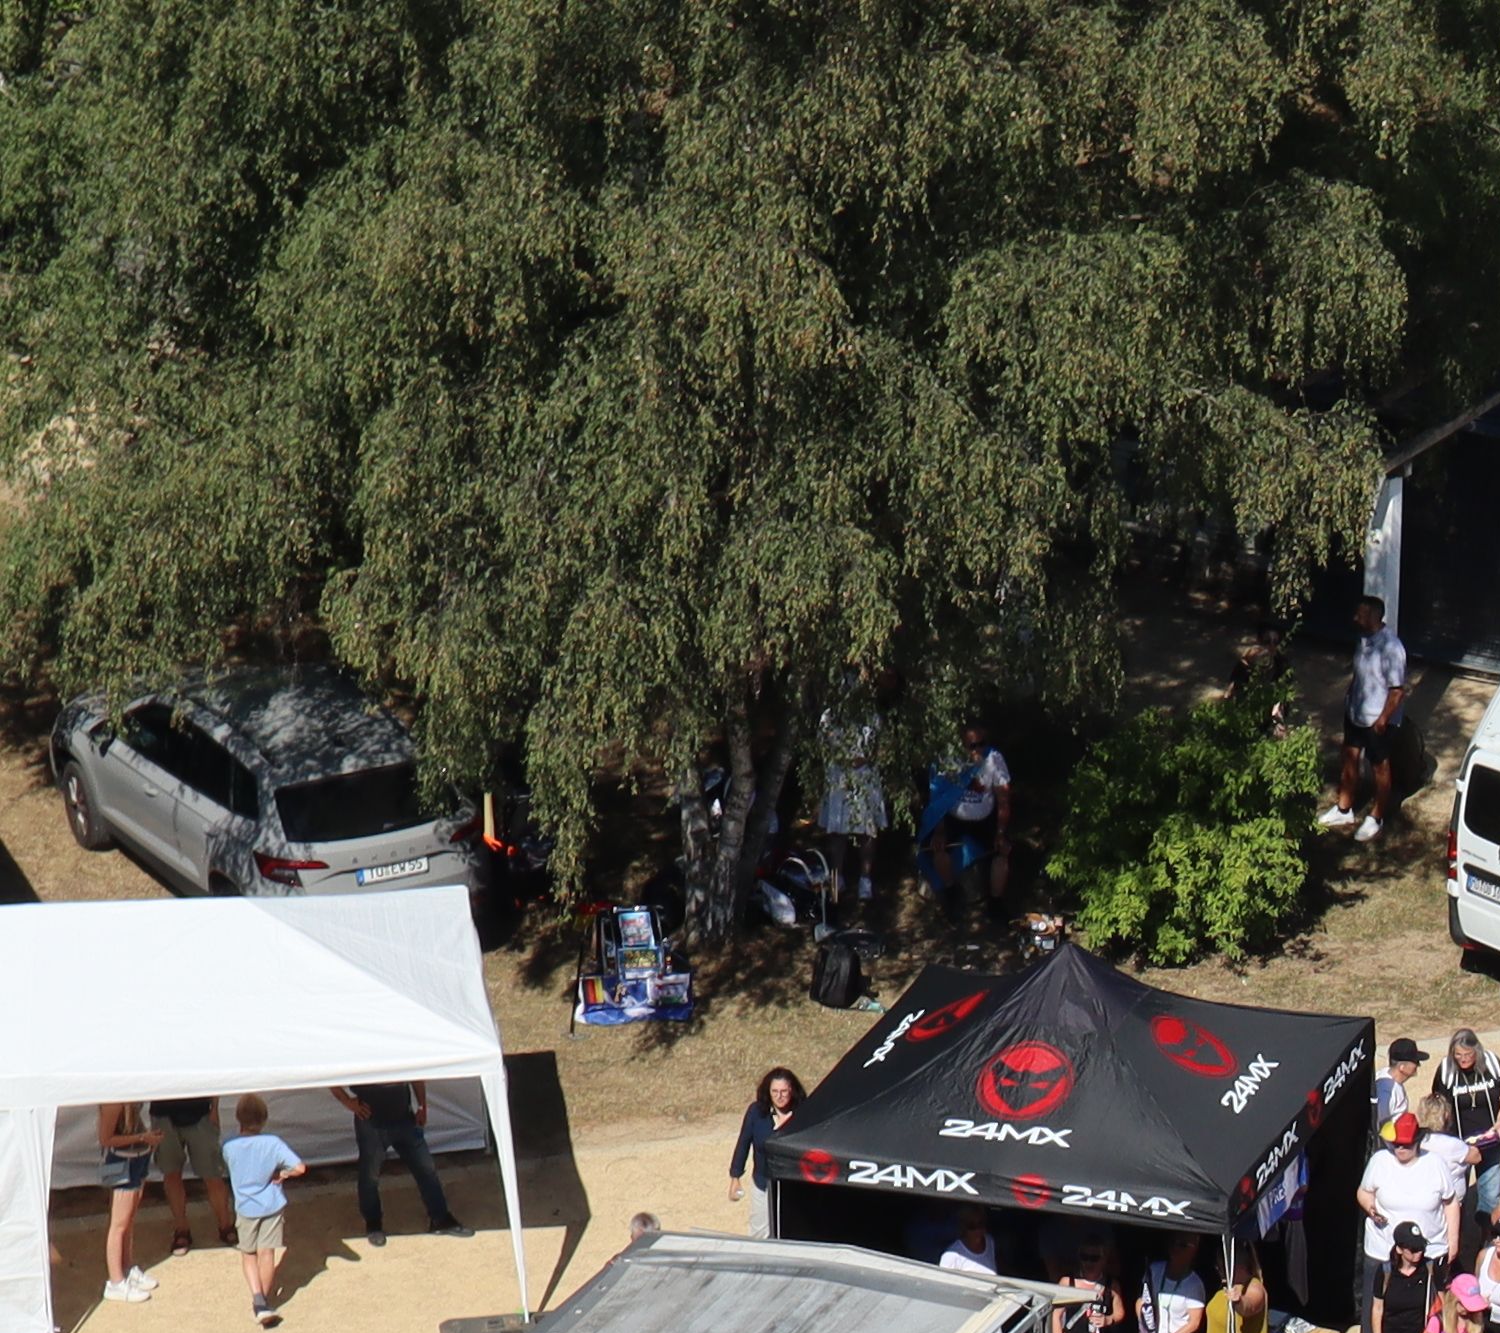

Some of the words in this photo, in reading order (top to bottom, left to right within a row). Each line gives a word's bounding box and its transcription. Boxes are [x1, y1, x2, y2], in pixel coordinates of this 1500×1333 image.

[1220, 1053, 1279, 1116] 24MX
[1322, 1039, 1367, 1105] 24MX
[939, 1119, 1073, 1149] 24MX
[1256, 1122, 1299, 1191] 24MX
[848, 1160, 979, 1196] 24MX
[1062, 1184, 1194, 1219] 24MX
